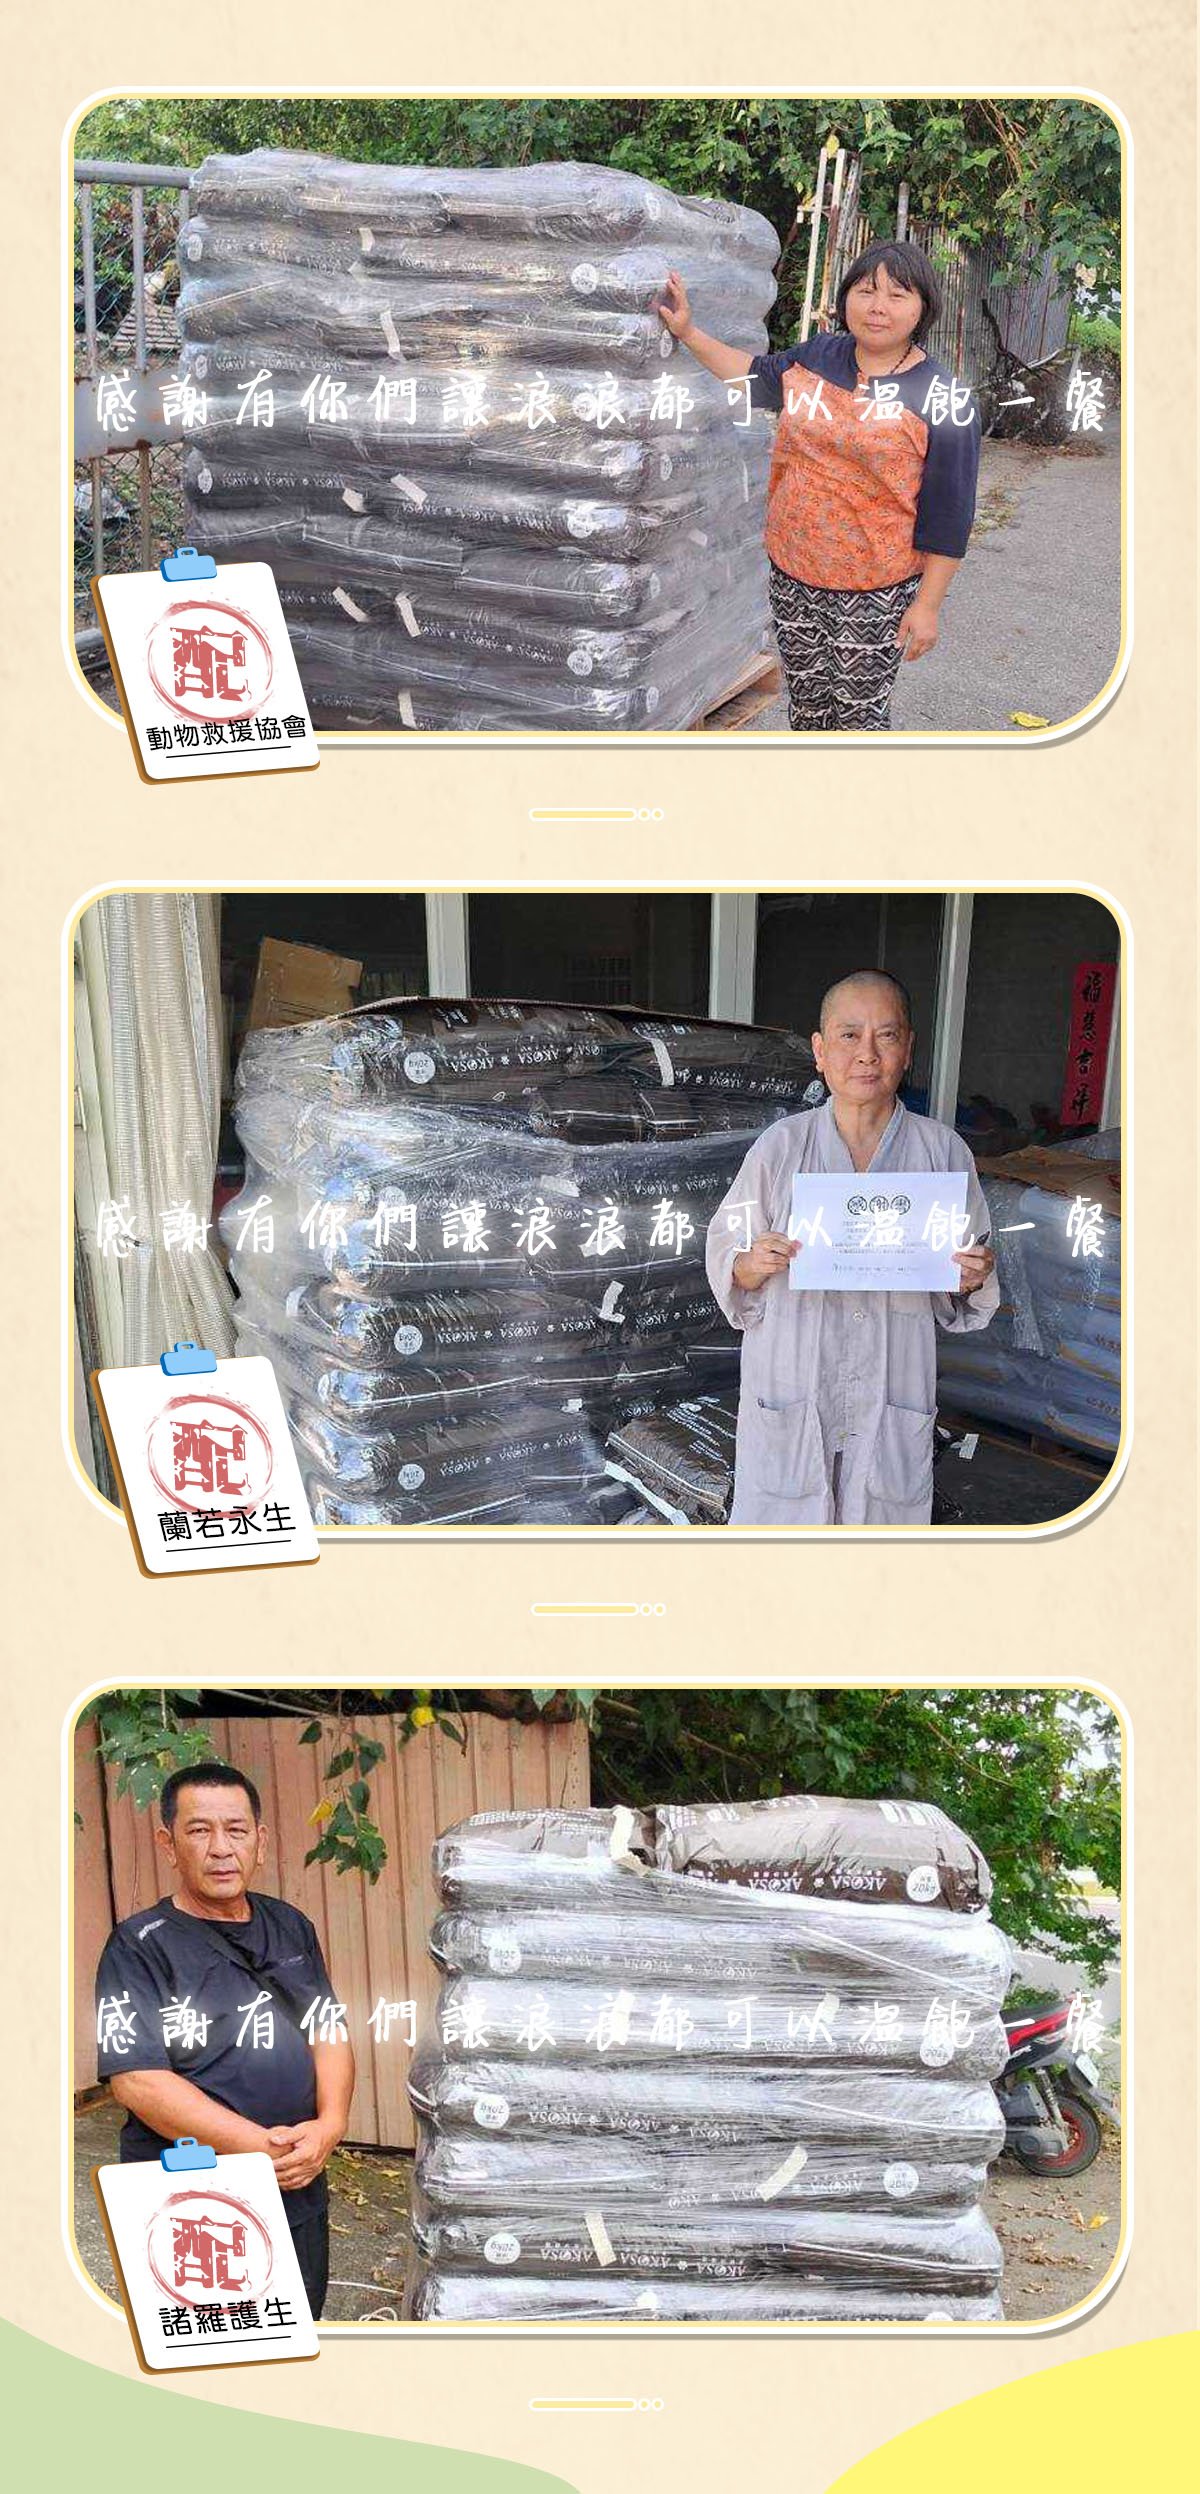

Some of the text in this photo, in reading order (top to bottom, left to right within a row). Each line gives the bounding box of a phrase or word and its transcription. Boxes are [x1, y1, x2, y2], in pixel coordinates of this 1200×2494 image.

[449, 1056, 494, 1073] AKOSA
[517, 1048, 559, 1065] AKOSA
[438, 1329, 478, 1344] AKOSA
[749, 1875, 887, 1893] AKOSA AKOSA
[530, 2111, 583, 2125] AKOSA
[540, 2248, 747, 2278] AKOSA AKOSA AKOSA
